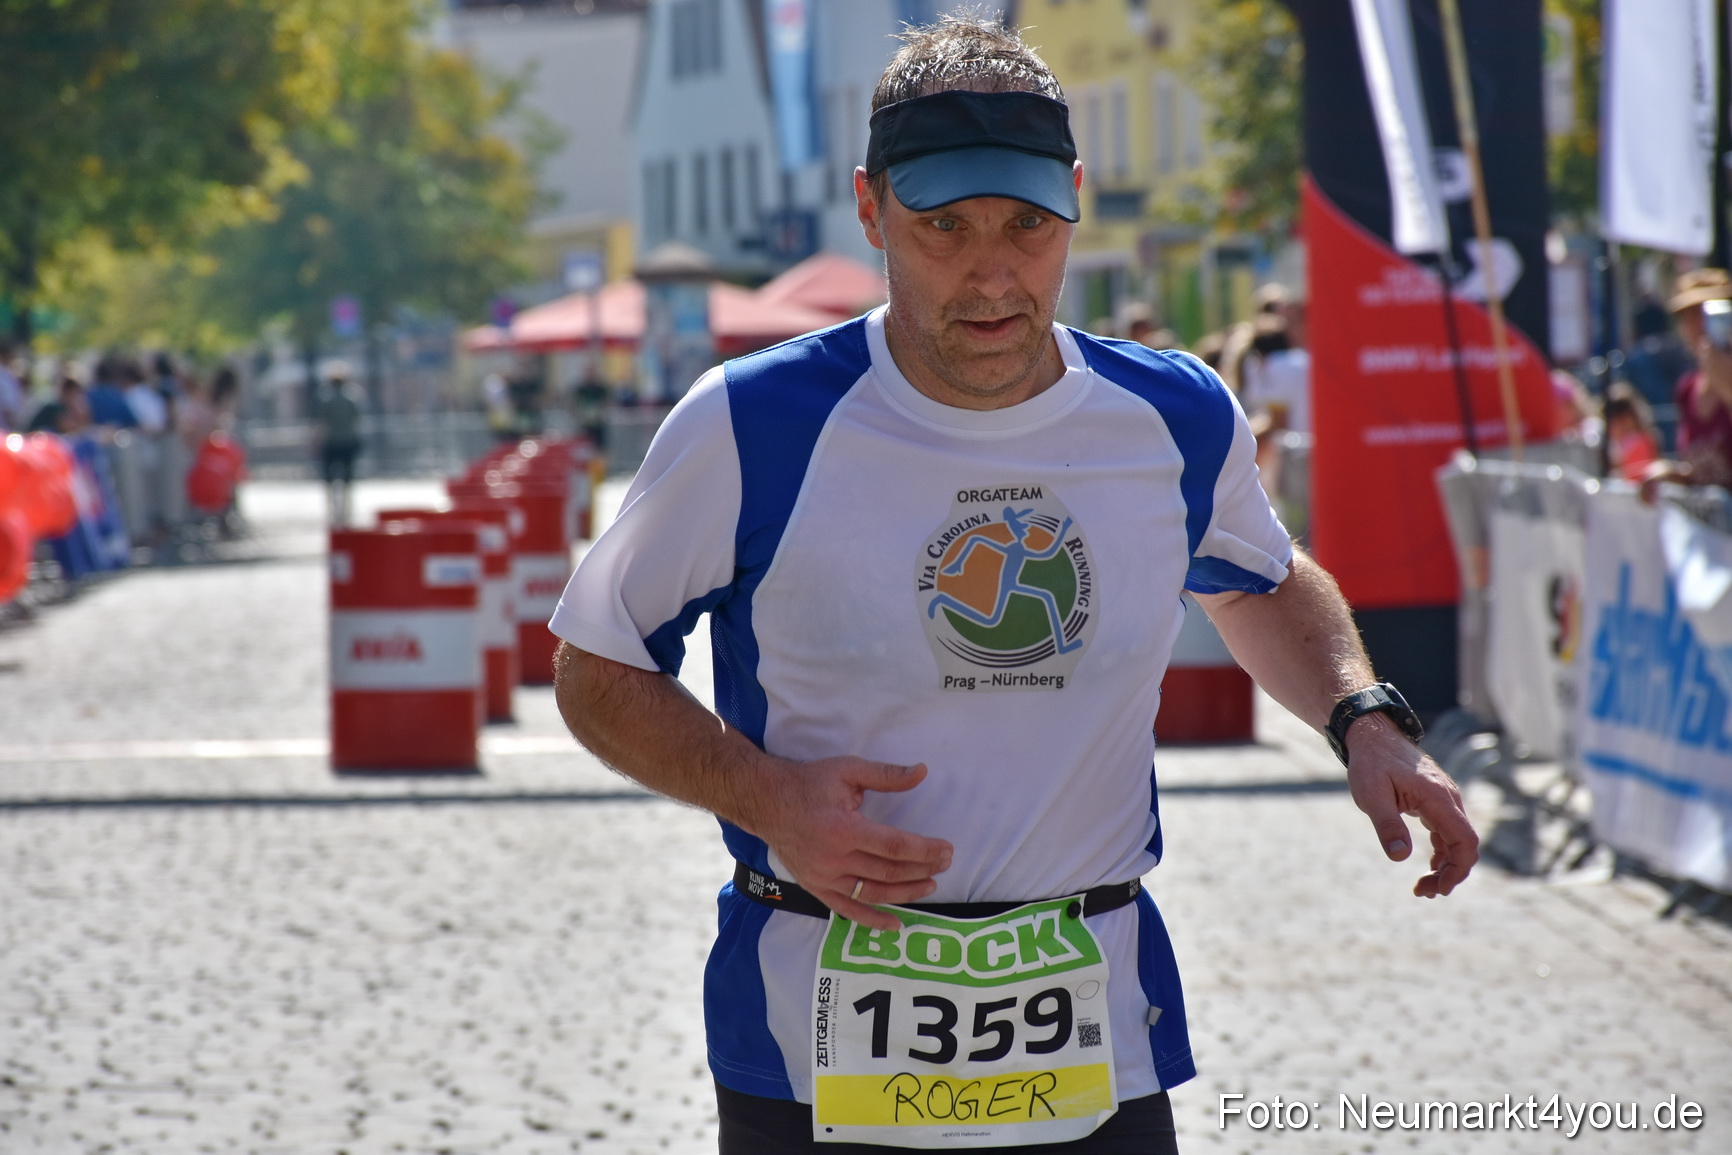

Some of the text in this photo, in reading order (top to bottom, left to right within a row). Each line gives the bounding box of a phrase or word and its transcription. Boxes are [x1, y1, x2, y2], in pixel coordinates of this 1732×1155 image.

[956, 486, 1044, 503] ORGATEAM
[919, 512, 1091, 608] VIA CAROLINA RUNNING
[943, 675, 976, 690] Prag
[747, 880, 765, 898] MOVE
[847, 911, 1073, 975] BOCK
[851, 986, 1074, 1065] 1359
[883, 1071, 1057, 1123] ROGER
